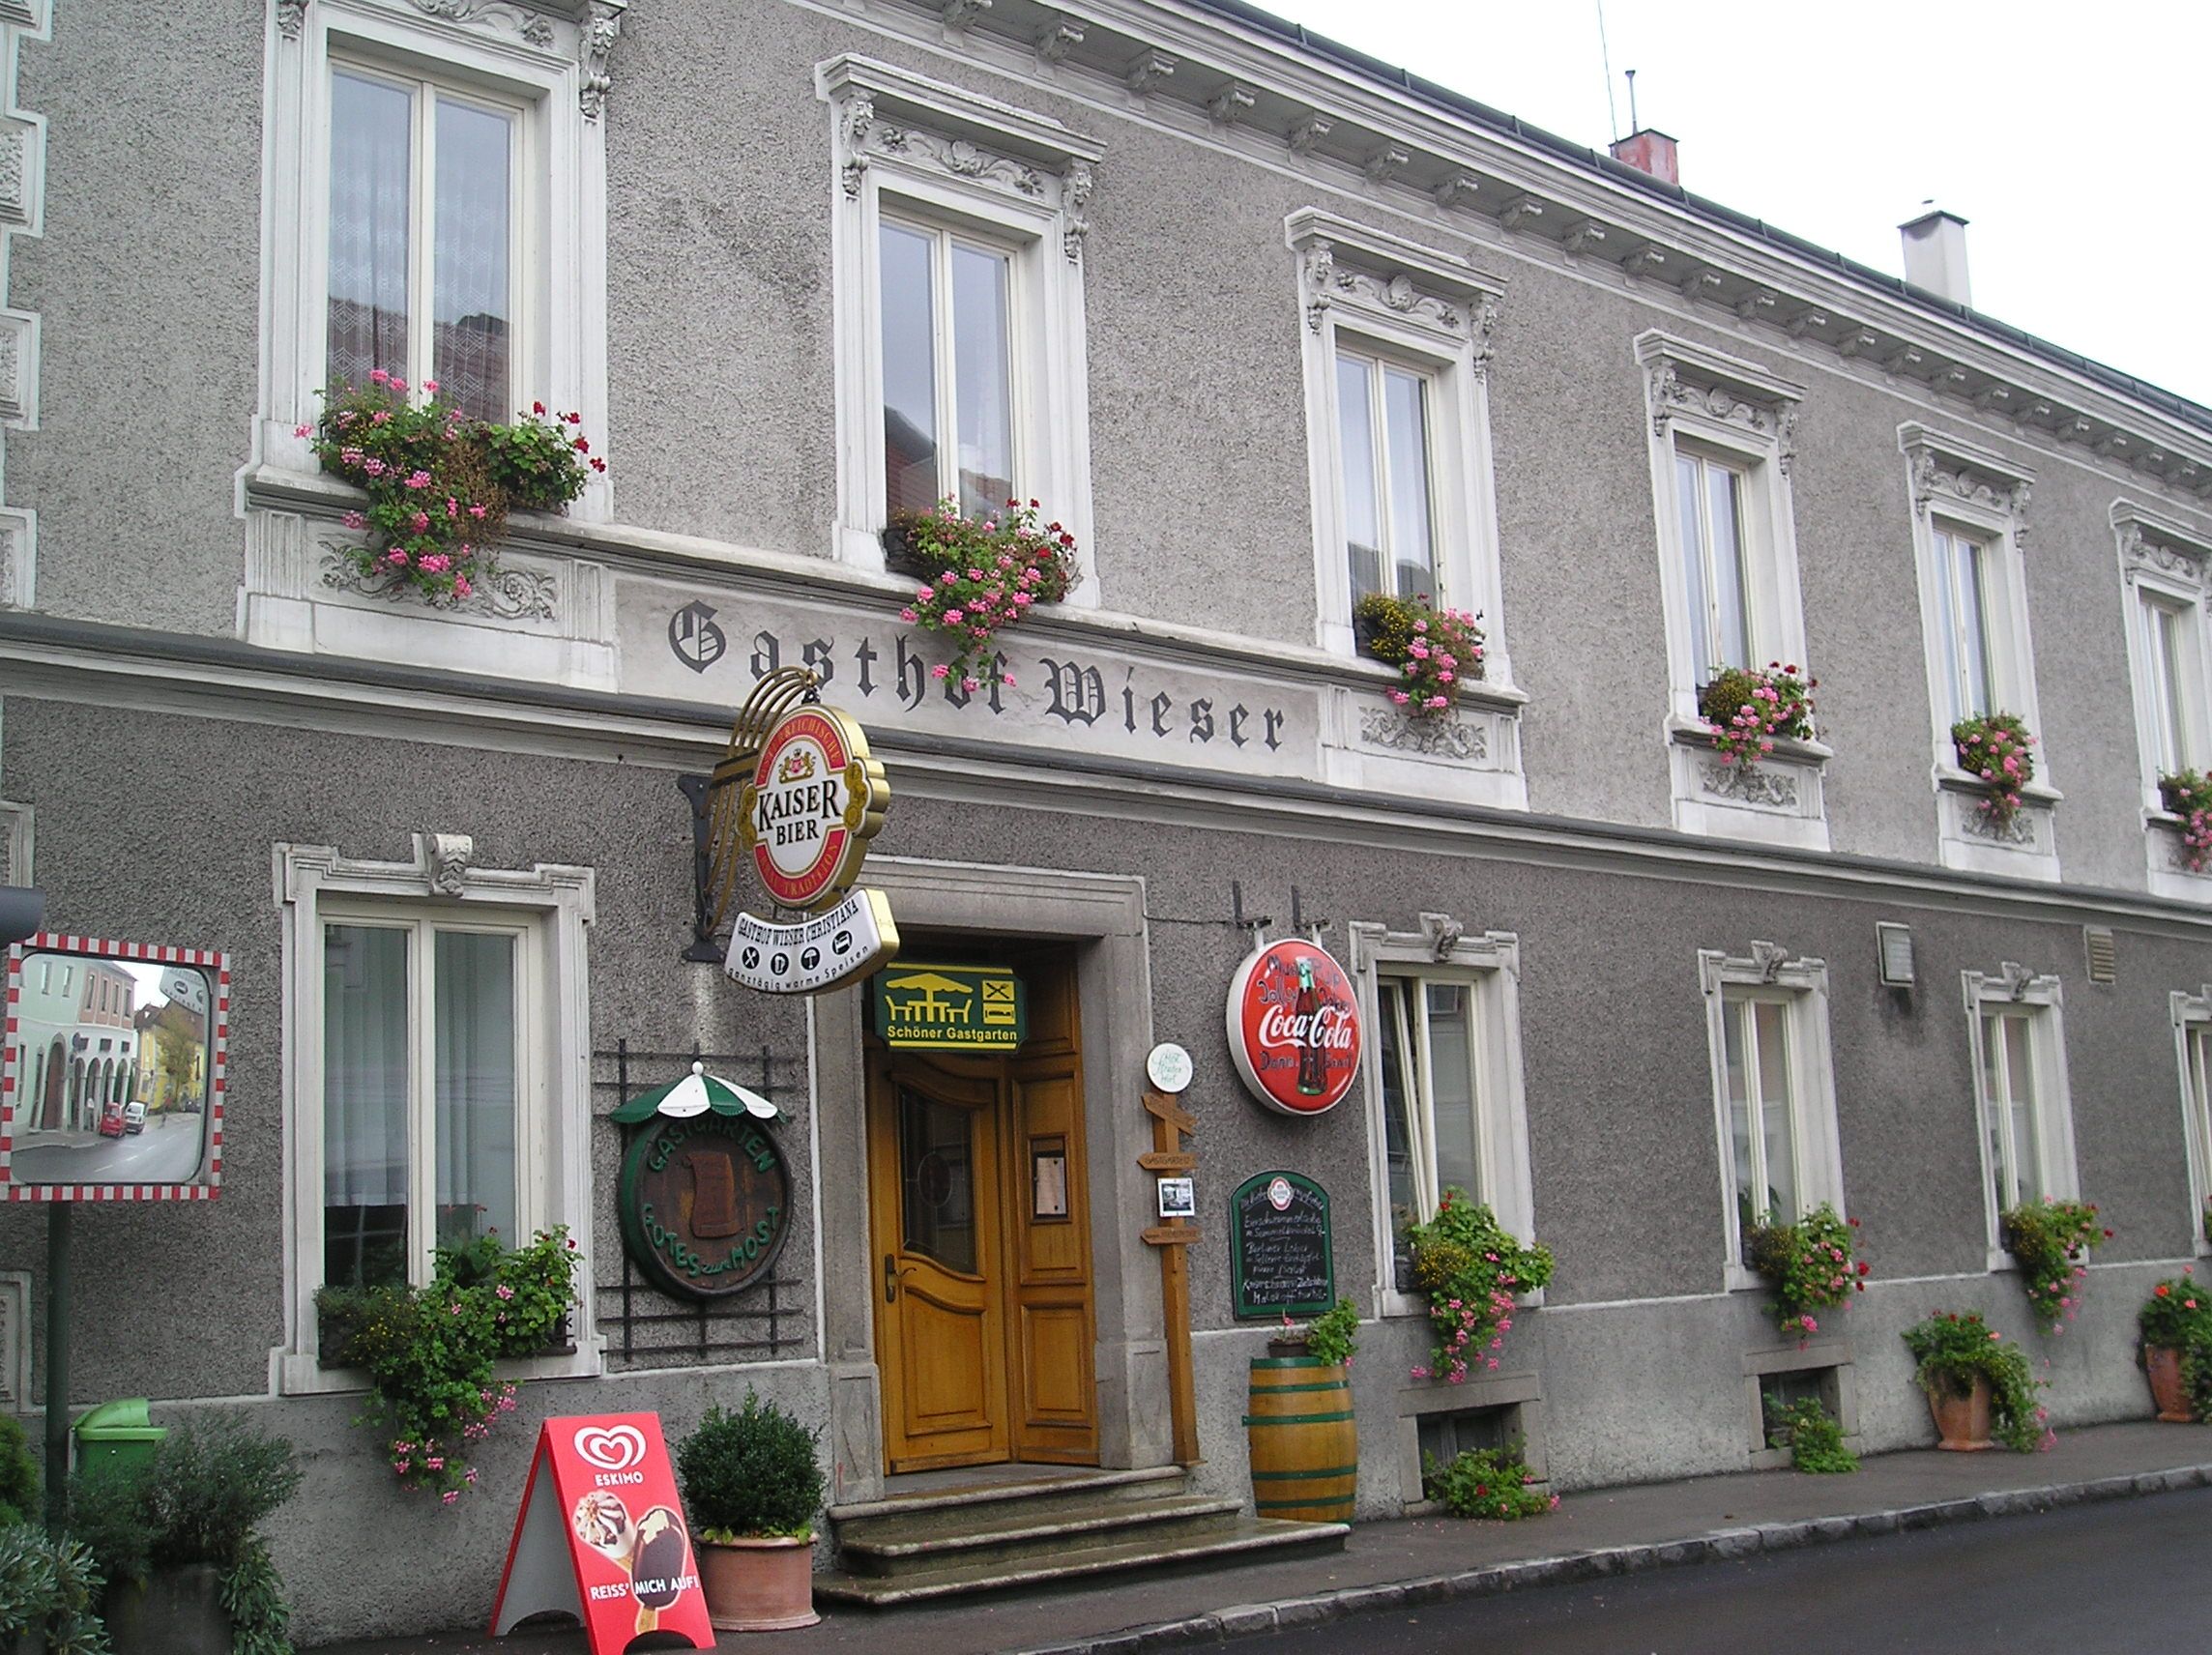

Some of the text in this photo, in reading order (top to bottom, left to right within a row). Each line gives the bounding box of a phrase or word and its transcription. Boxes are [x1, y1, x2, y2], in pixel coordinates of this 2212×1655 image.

[668, 599, 1284, 751] Gasthof Wieser
[758, 779, 843, 831] KAISER
[775, 819, 820, 846] BIER
[738, 898, 859, 946] GASTHOF WIESER CHRISTIANA
[728, 945, 869, 992] ganztägig warme Speisen
[888, 1026, 1016, 1042] Schöner Gastgarten
[650, 1119, 774, 1172] GASTGARTEN
[732, 1206, 778, 1269] MOST
[595, 1471, 644, 1487] ESKIMO
[590, 1575, 700, 1601] REISS' MICH AUF!
